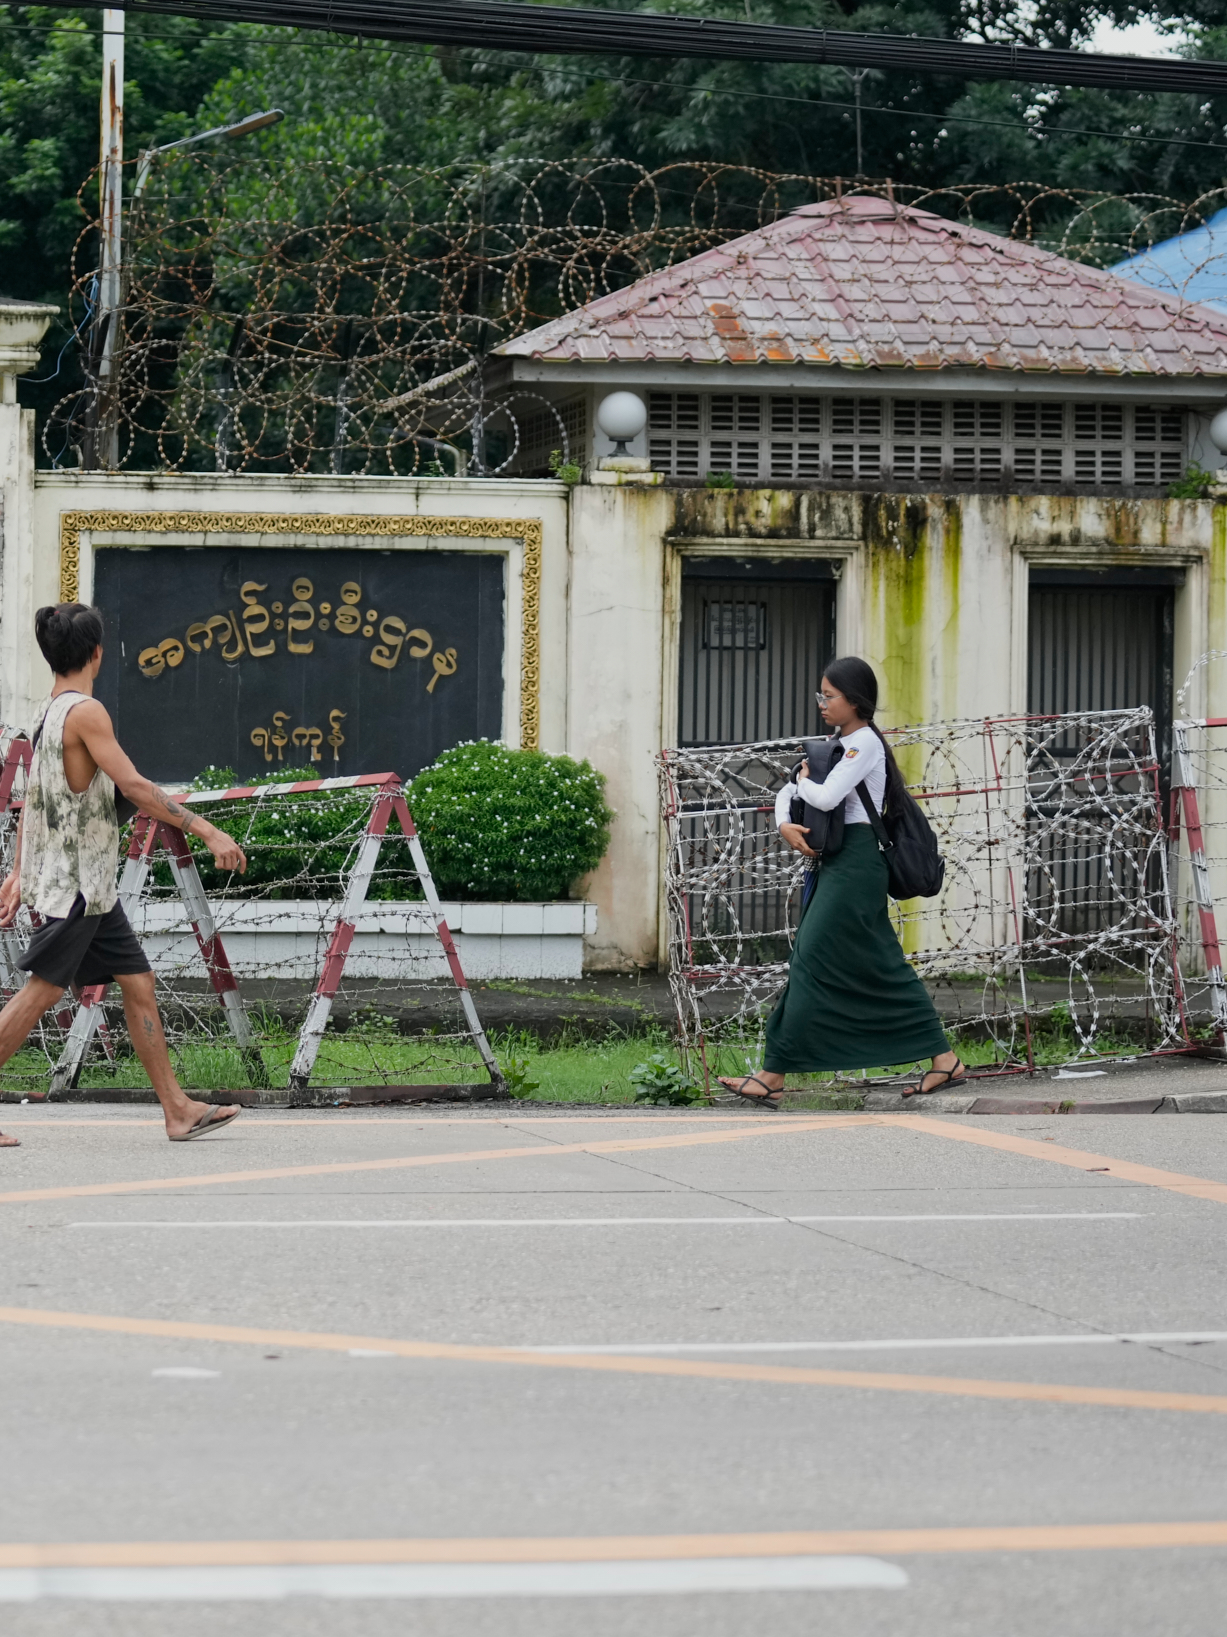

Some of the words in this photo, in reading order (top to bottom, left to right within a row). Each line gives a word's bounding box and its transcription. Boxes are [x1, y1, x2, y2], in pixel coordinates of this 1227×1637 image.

[137, 577, 458, 694] အကျဉ်းဦးစီးဌာန
[250, 709, 347, 762] ရန်ကုန်
